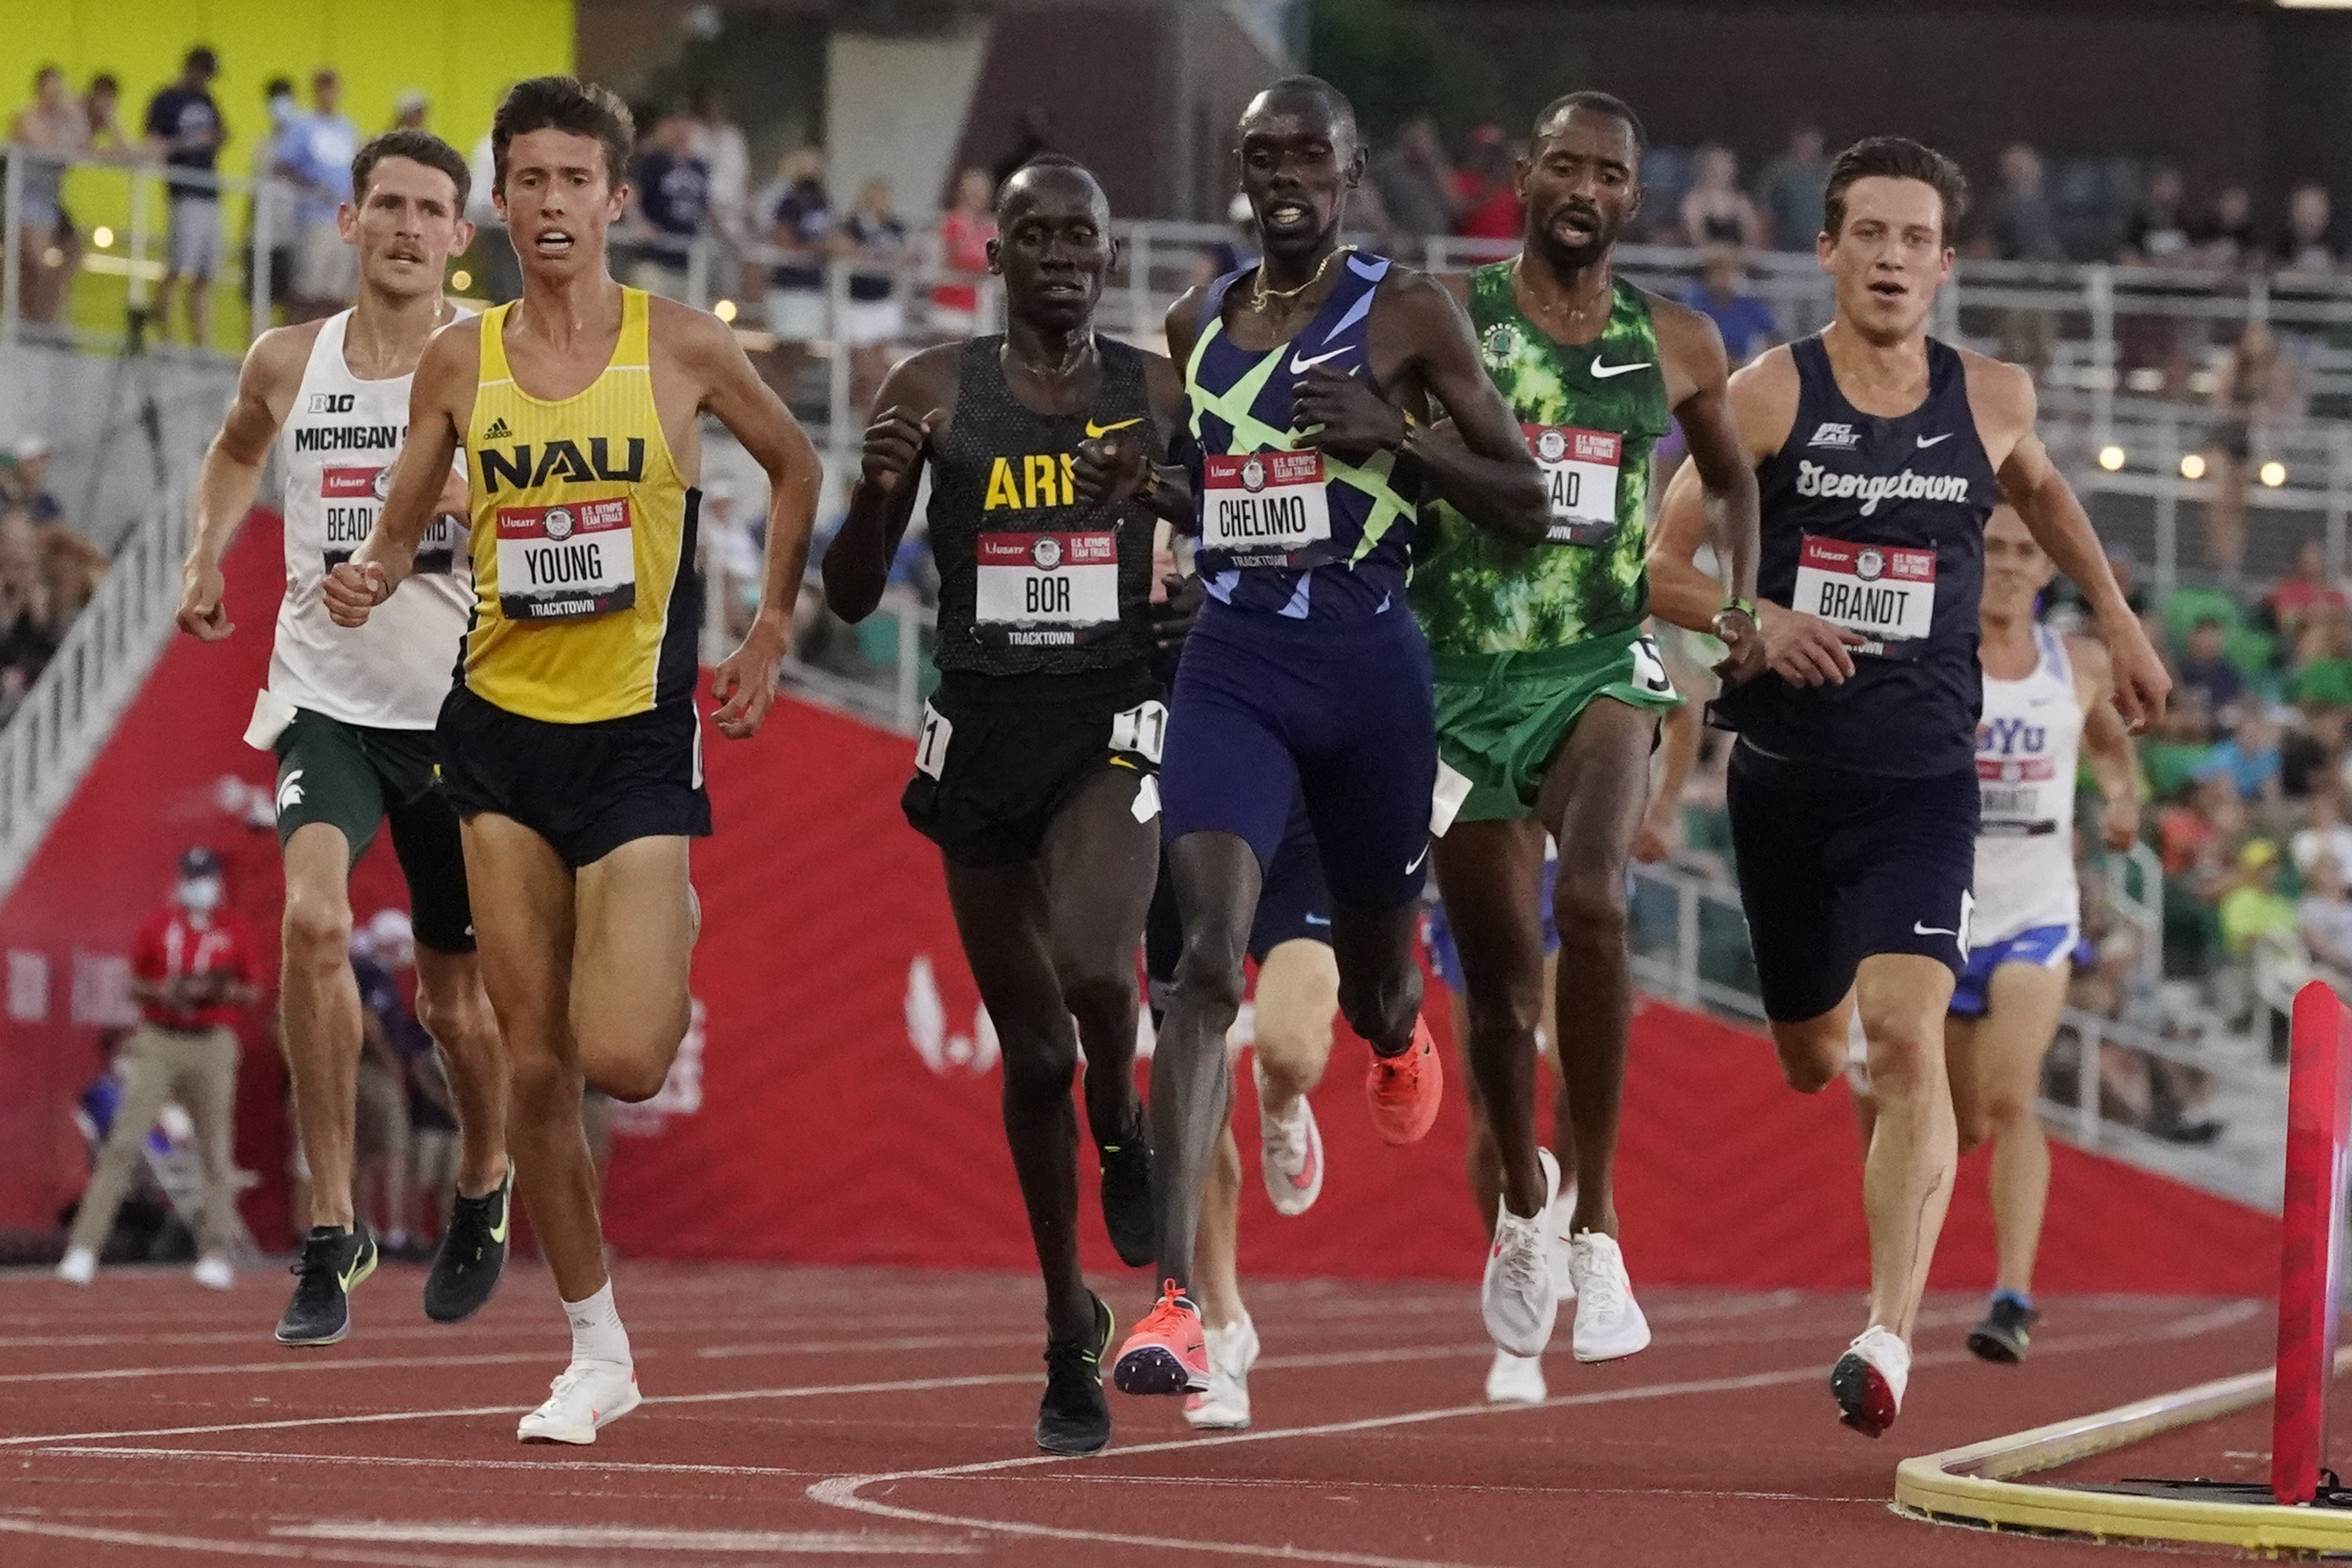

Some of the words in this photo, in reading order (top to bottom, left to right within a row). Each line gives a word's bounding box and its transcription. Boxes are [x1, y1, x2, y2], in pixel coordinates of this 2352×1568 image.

[294, 425, 398, 452] MICHIGAN
[484, 430, 513, 440] adidas
[478, 437, 645, 494] NAU
[1796, 460, 1969, 517] Georgetown
[1219, 495, 1306, 538] CHELIMO
[525, 543, 603, 585] YOUNG
[1231, 554, 1288, 567] TRACKTOWN
[529, 599, 595, 616] TRACKTOWN
[1026, 576, 1070, 613] BOR
[1819, 581, 1910, 625] BRANDT
[1008, 632, 1074, 645] TRACKTOWN
